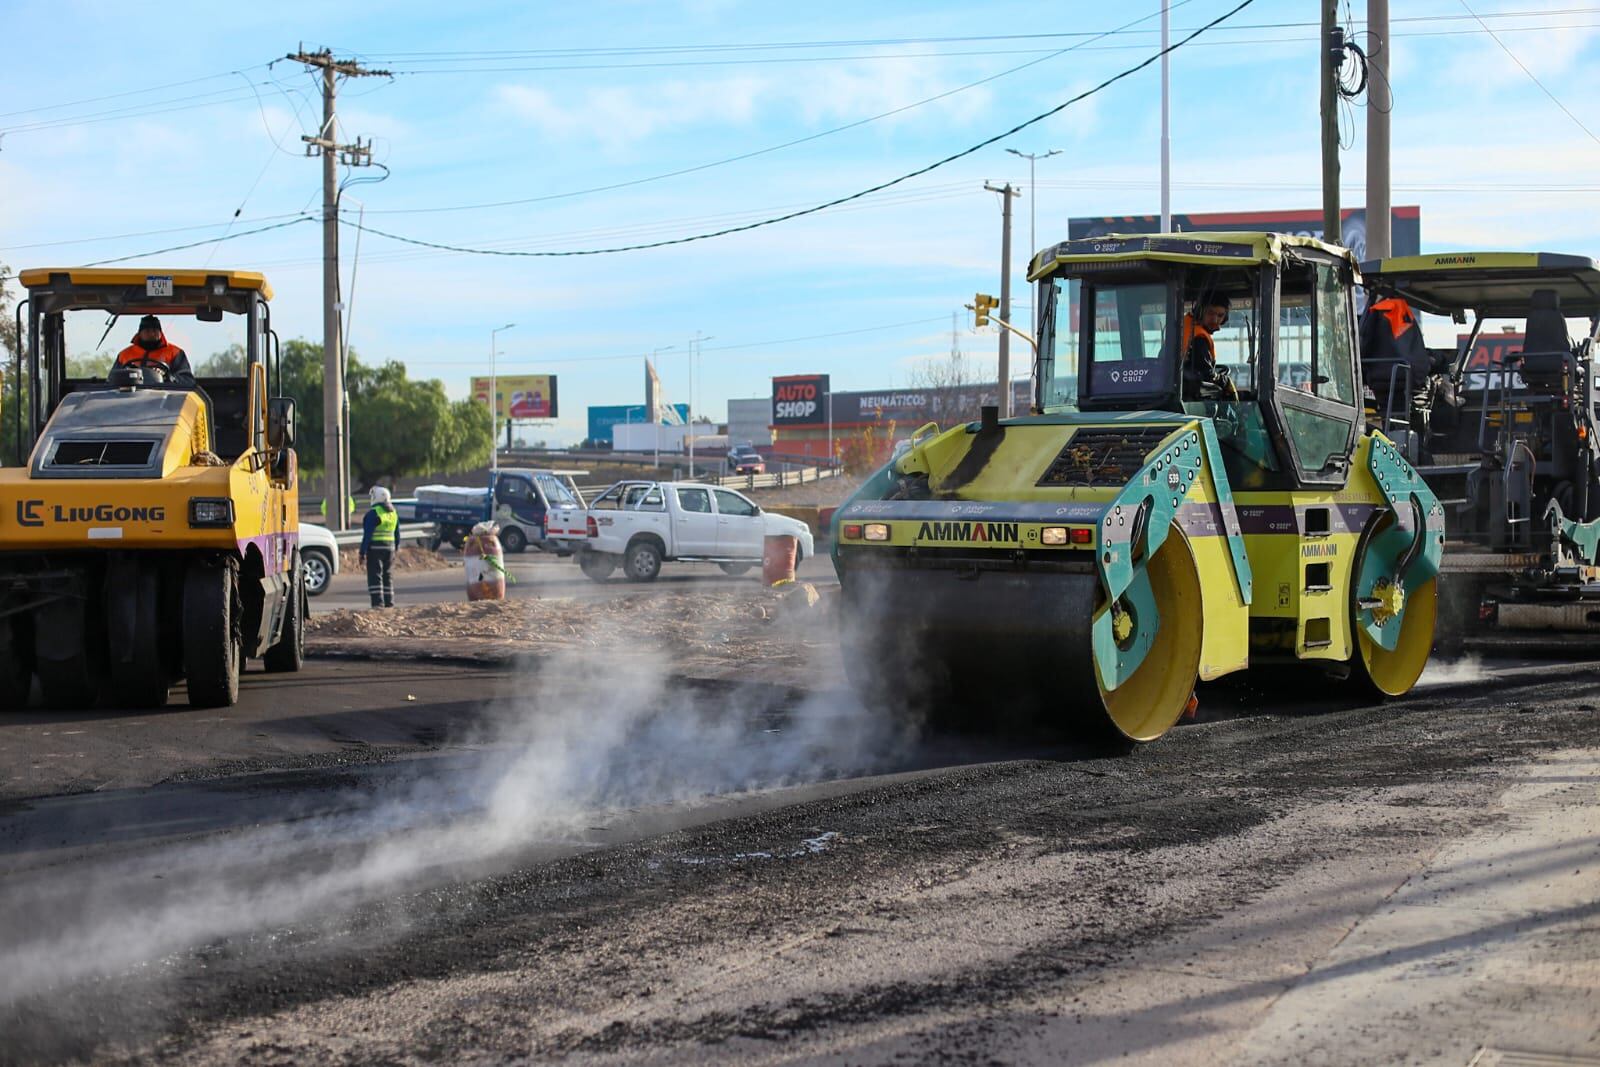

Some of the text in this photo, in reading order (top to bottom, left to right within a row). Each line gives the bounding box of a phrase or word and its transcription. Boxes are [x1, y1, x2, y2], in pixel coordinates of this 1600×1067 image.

[1434, 256, 1476, 264] AMMANN
[775, 384, 817, 400] AUTO
[776, 401, 817, 418] SHOP
[1168, 473, 1180, 484] 539
[917, 522, 1019, 542] AMMANN
[1301, 543, 1337, 558] AMMANN
